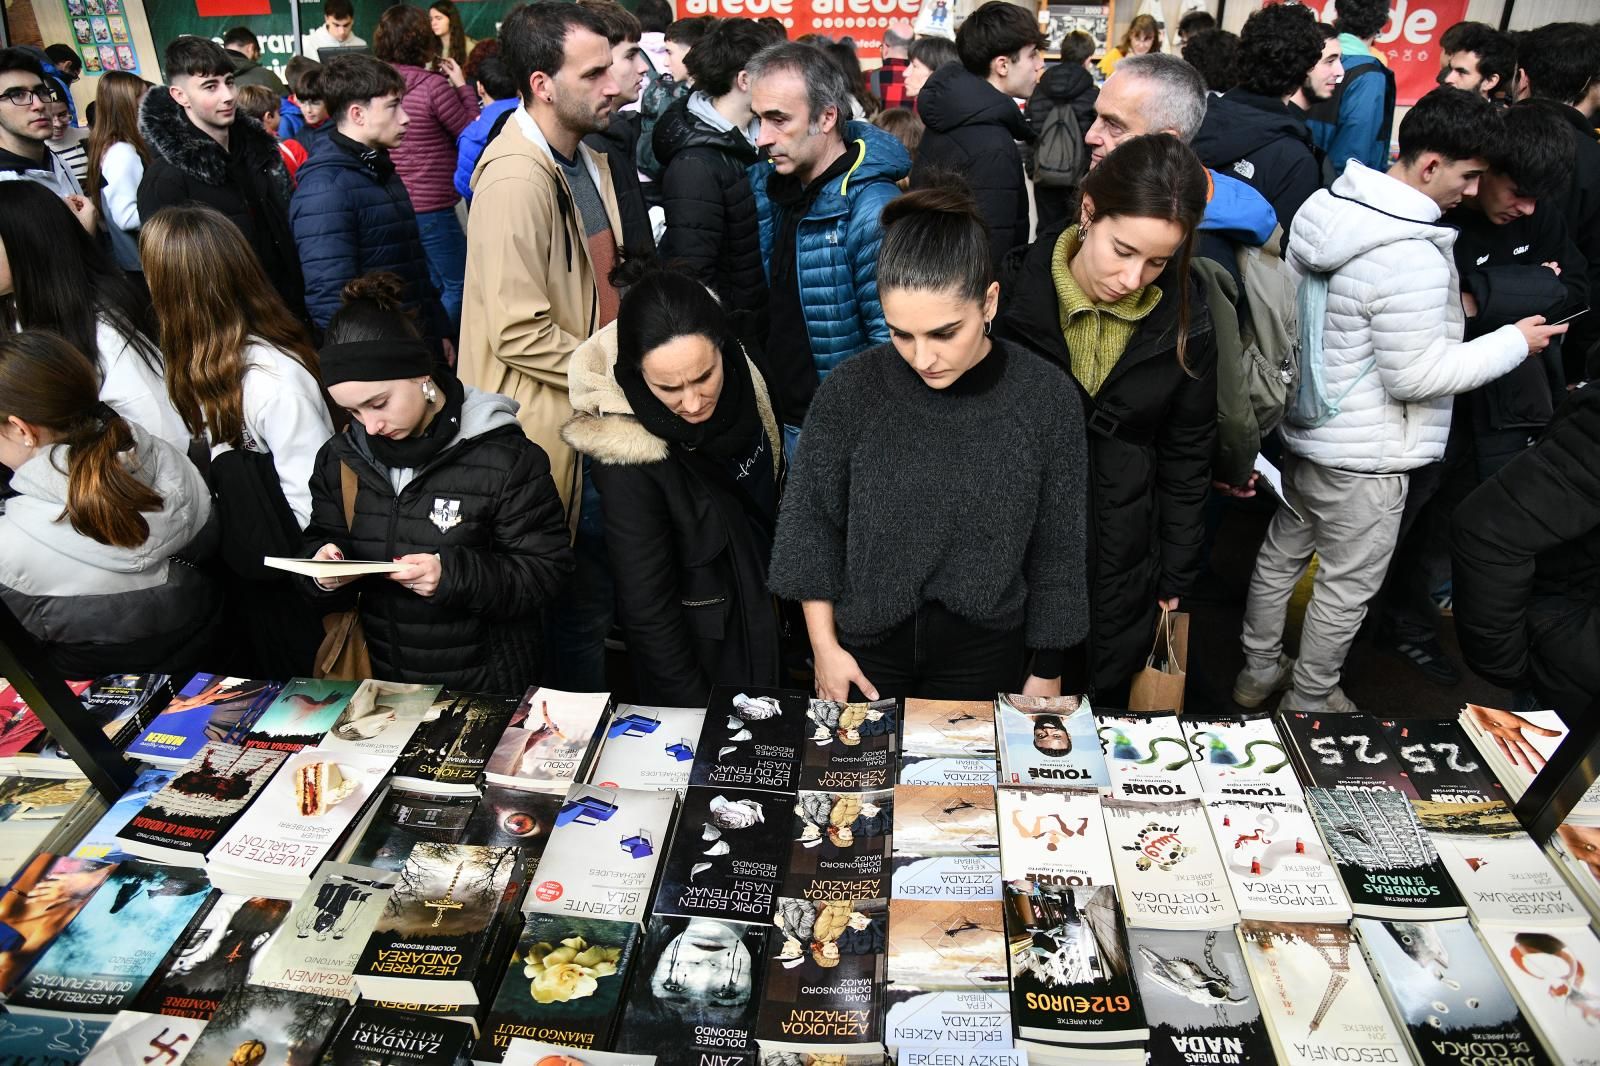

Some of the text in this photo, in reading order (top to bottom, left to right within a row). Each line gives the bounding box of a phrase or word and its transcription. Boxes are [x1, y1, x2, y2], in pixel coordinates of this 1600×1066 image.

[144, 731, 187, 746] MAREN
[246, 740, 270, 749] ROJA
[271, 742, 304, 751] SIRENA
[754, 744, 794, 753] REDONDO
[1310, 735, 1388, 765] 25
[755, 749, 794, 758] DOLORES
[831, 754, 887, 762] DORRONSORO
[862, 749, 887, 757] MAIOZ
[1400, 743, 1479, 774] 25
[418, 764, 478, 778] 72 HORAS
[543, 761, 574, 769] ORDU
[714, 764, 790, 778] EZ DUTENAK
[757, 760, 791, 770] NASH
[556, 770, 570, 778] 72
[708, 773, 790, 787] LORIK EGITEN
[824, 769, 887, 779] AZPIAZUN
[943, 773, 989, 781] ZIZTADA
[1028, 768, 1091, 780] TOURÉ
[817, 777, 886, 787] AZPIJOKOA
[1122, 782, 1186, 795] TOURÉ
[131, 815, 216, 840] LA CHICA OLVIDADA
[238, 834, 319, 856] EL CARLTON
[219, 841, 310, 867] MUERTE EN
[854, 854, 882, 863] MAIOZ
[732, 860, 778, 871] REDONDO
[820, 860, 882, 868] DORRONSORO
[1282, 864, 1321, 872] ARRETXE
[733, 867, 776, 878] DOLORES
[1174, 873, 1212, 881] ARRETXE
[811, 879, 880, 889] AZPIAZUN
[940, 875, 993, 884] ZIZTADA
[1196, 879, 1214, 887] JON
[1364, 873, 1412, 886] NADA
[734, 881, 774, 893] NASH
[899, 885, 994, 894] ERLEEN AZKEN
[1242, 882, 1330, 894] LA LYRICA
[1363, 883, 1441, 897] SOMBRAS
[607, 891, 641, 903] ISILA
[685, 886, 772, 902] EZ DUTENAK
[803, 888, 880, 900] AZPIJOKOA
[1131, 890, 1220, 904] TORTUGA
[1473, 890, 1562, 902] AMARRUAK
[678, 896, 770, 914] LORIK EGITEN
[1267, 895, 1338, 906] TIEMPOS
[563, 899, 638, 916] PAZIENTE
[1146, 905, 1209, 915] MIRADA
[1511, 902, 1574, 913] MUSKER
[377, 950, 462, 964] ONDAREA
[370, 961, 458, 976] HEZURREN
[32, 974, 133, 991] QUINCE PUNTAS
[840, 978, 872, 987] MAIOZ
[25, 987, 124, 1005] LA ESTRELLA DE
[801, 986, 872, 994] DORRONSORO
[844, 993, 871, 1002] IÑAKI
[957, 994, 987, 1002] IRIBAR
[966, 1002, 993, 1010] KEPA
[790, 1009, 870, 1022] AZPIAZUN
[942, 1015, 1001, 1027] ZIZTADA
[495, 1024, 594, 1043] EMANGO DIZUT
[694, 1026, 748, 1038] REDONDO
[781, 1021, 869, 1035] AZPIJOKOA
[894, 1027, 1002, 1041] ERLEEN AZKEN
[1341, 1024, 1385, 1032] ARRETXE
[352, 1029, 440, 1053] ZAINDARI
[695, 1036, 747, 1048] DOLORES
[1170, 1036, 1242, 1053] NADA
[354, 1044, 424, 1060] DOLORES REDONDO
[1293, 1043, 1398, 1063] DESCONFÍA
[1432, 1041, 1530, 1056] DE CLOACA
[907, 1054, 1020, 1066] ERLEEN AZKEN
[1184, 1053, 1239, 1064] NO DIGAS
